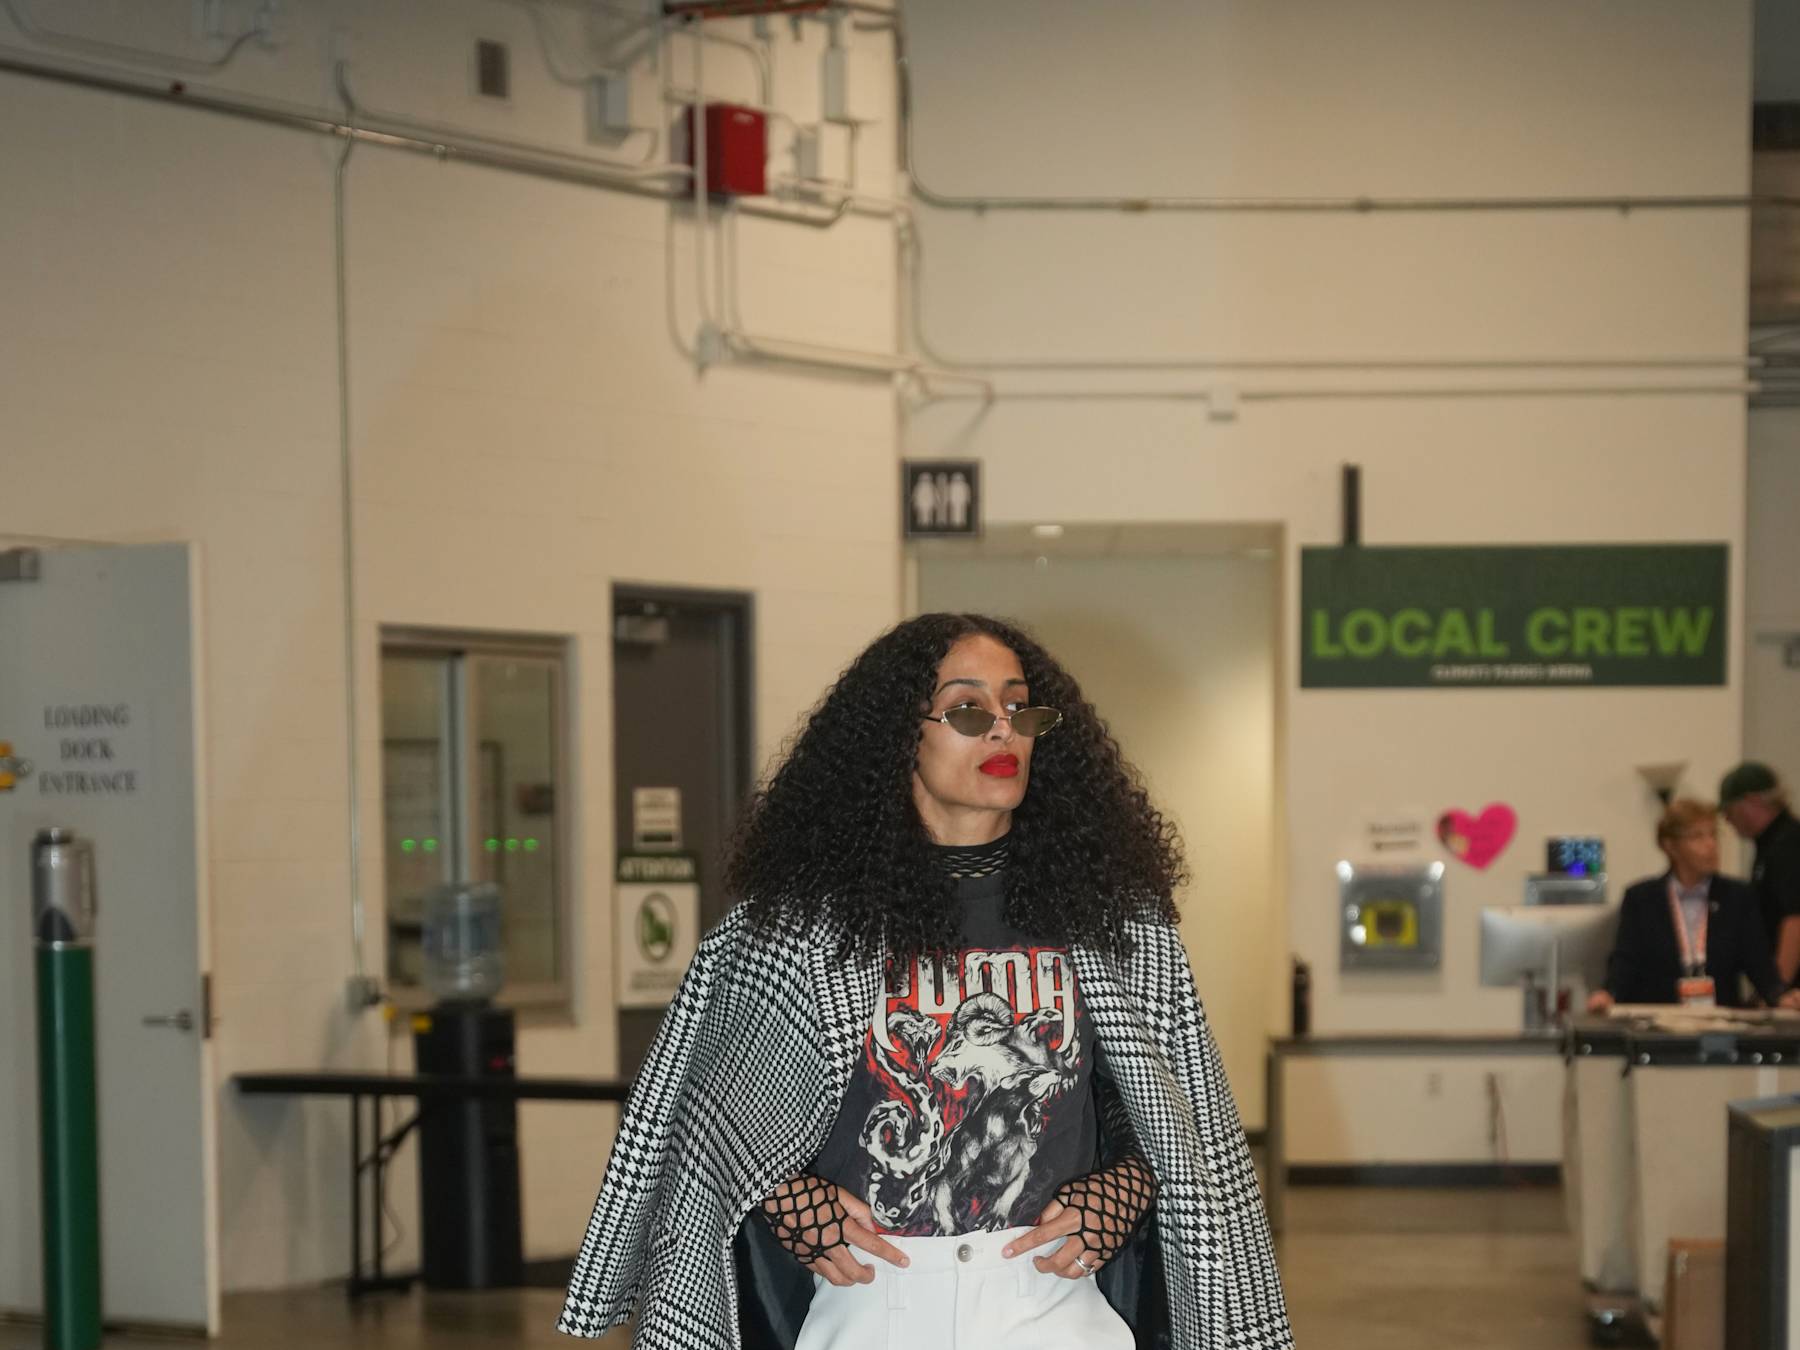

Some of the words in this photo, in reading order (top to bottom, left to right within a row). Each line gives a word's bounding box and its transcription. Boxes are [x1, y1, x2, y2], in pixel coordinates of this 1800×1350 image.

[1311, 607, 1510, 658] LOCAL
[1525, 607, 1713, 657] CREW
[44, 704, 131, 729] LOADING
[60, 737, 116, 760] DOCK
[39, 770, 138, 794] ENTRANCE
